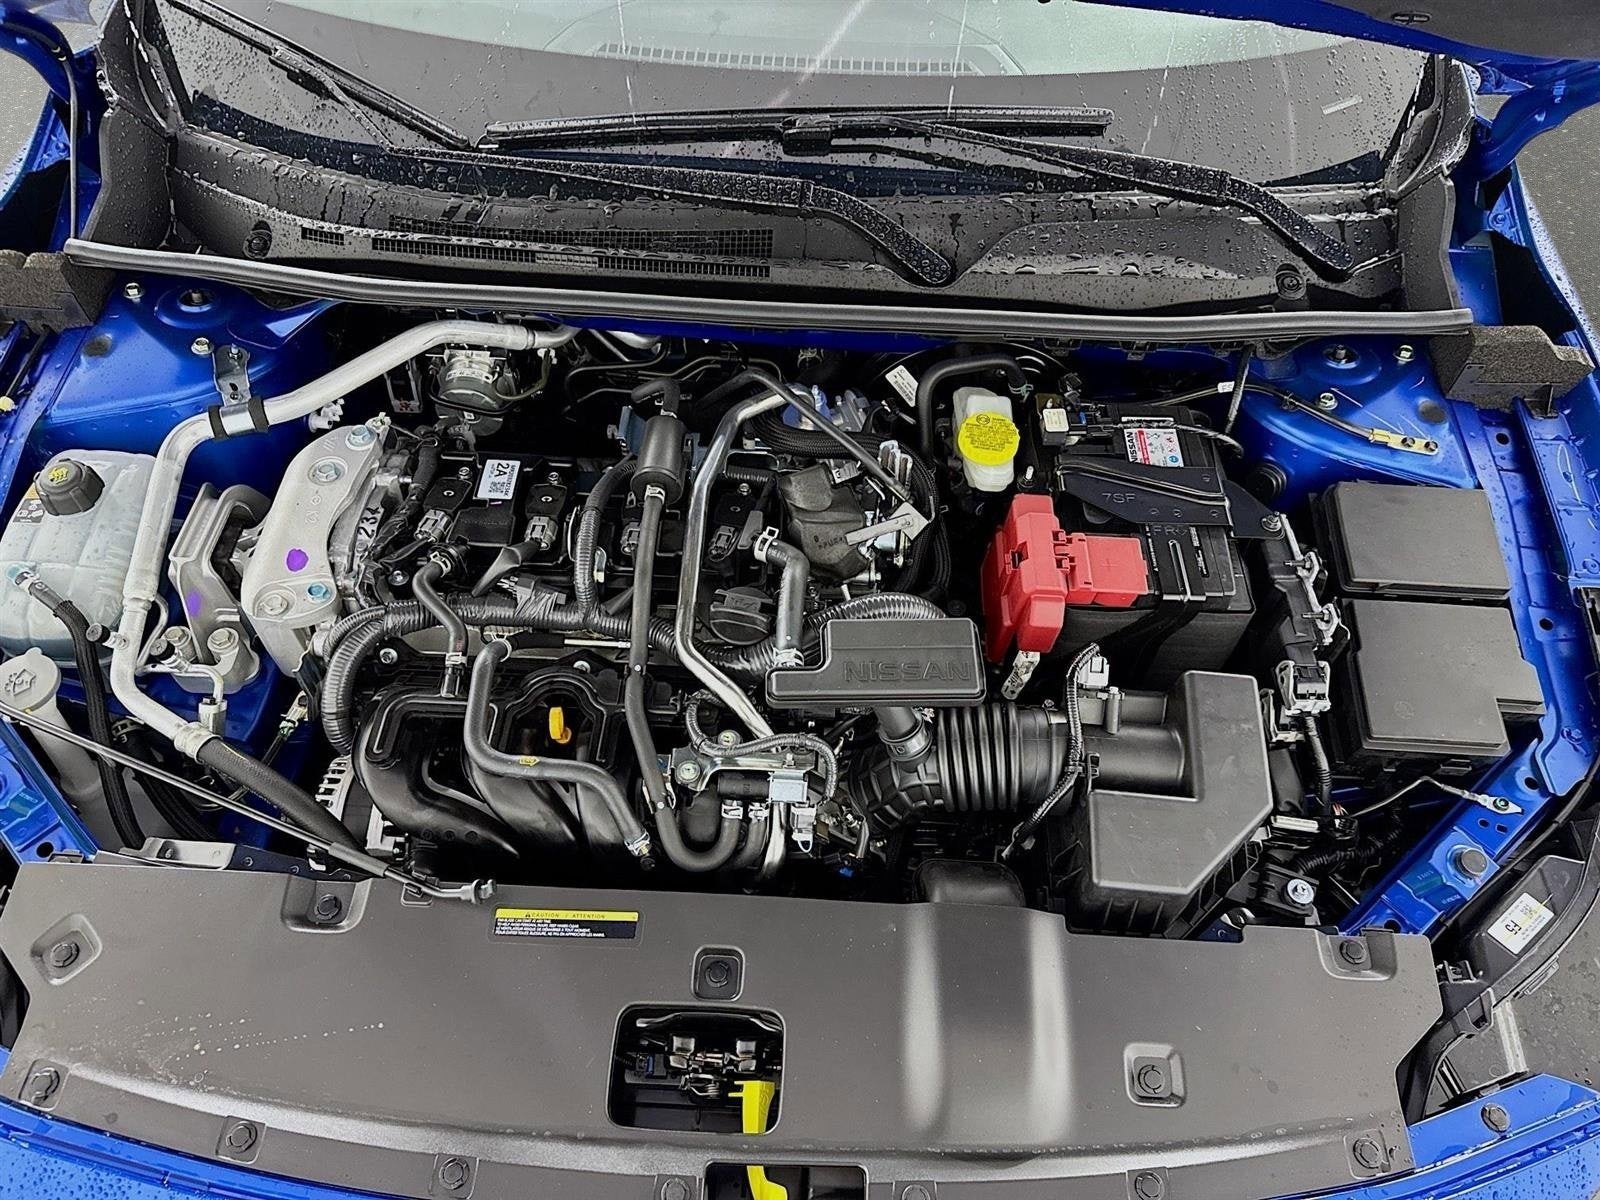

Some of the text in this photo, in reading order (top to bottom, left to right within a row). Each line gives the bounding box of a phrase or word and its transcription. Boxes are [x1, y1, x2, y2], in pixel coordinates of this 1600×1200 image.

[495, 462, 510, 478] 2A
[842, 660, 972, 682] NISSAN
[1504, 919, 1522, 935] F5
